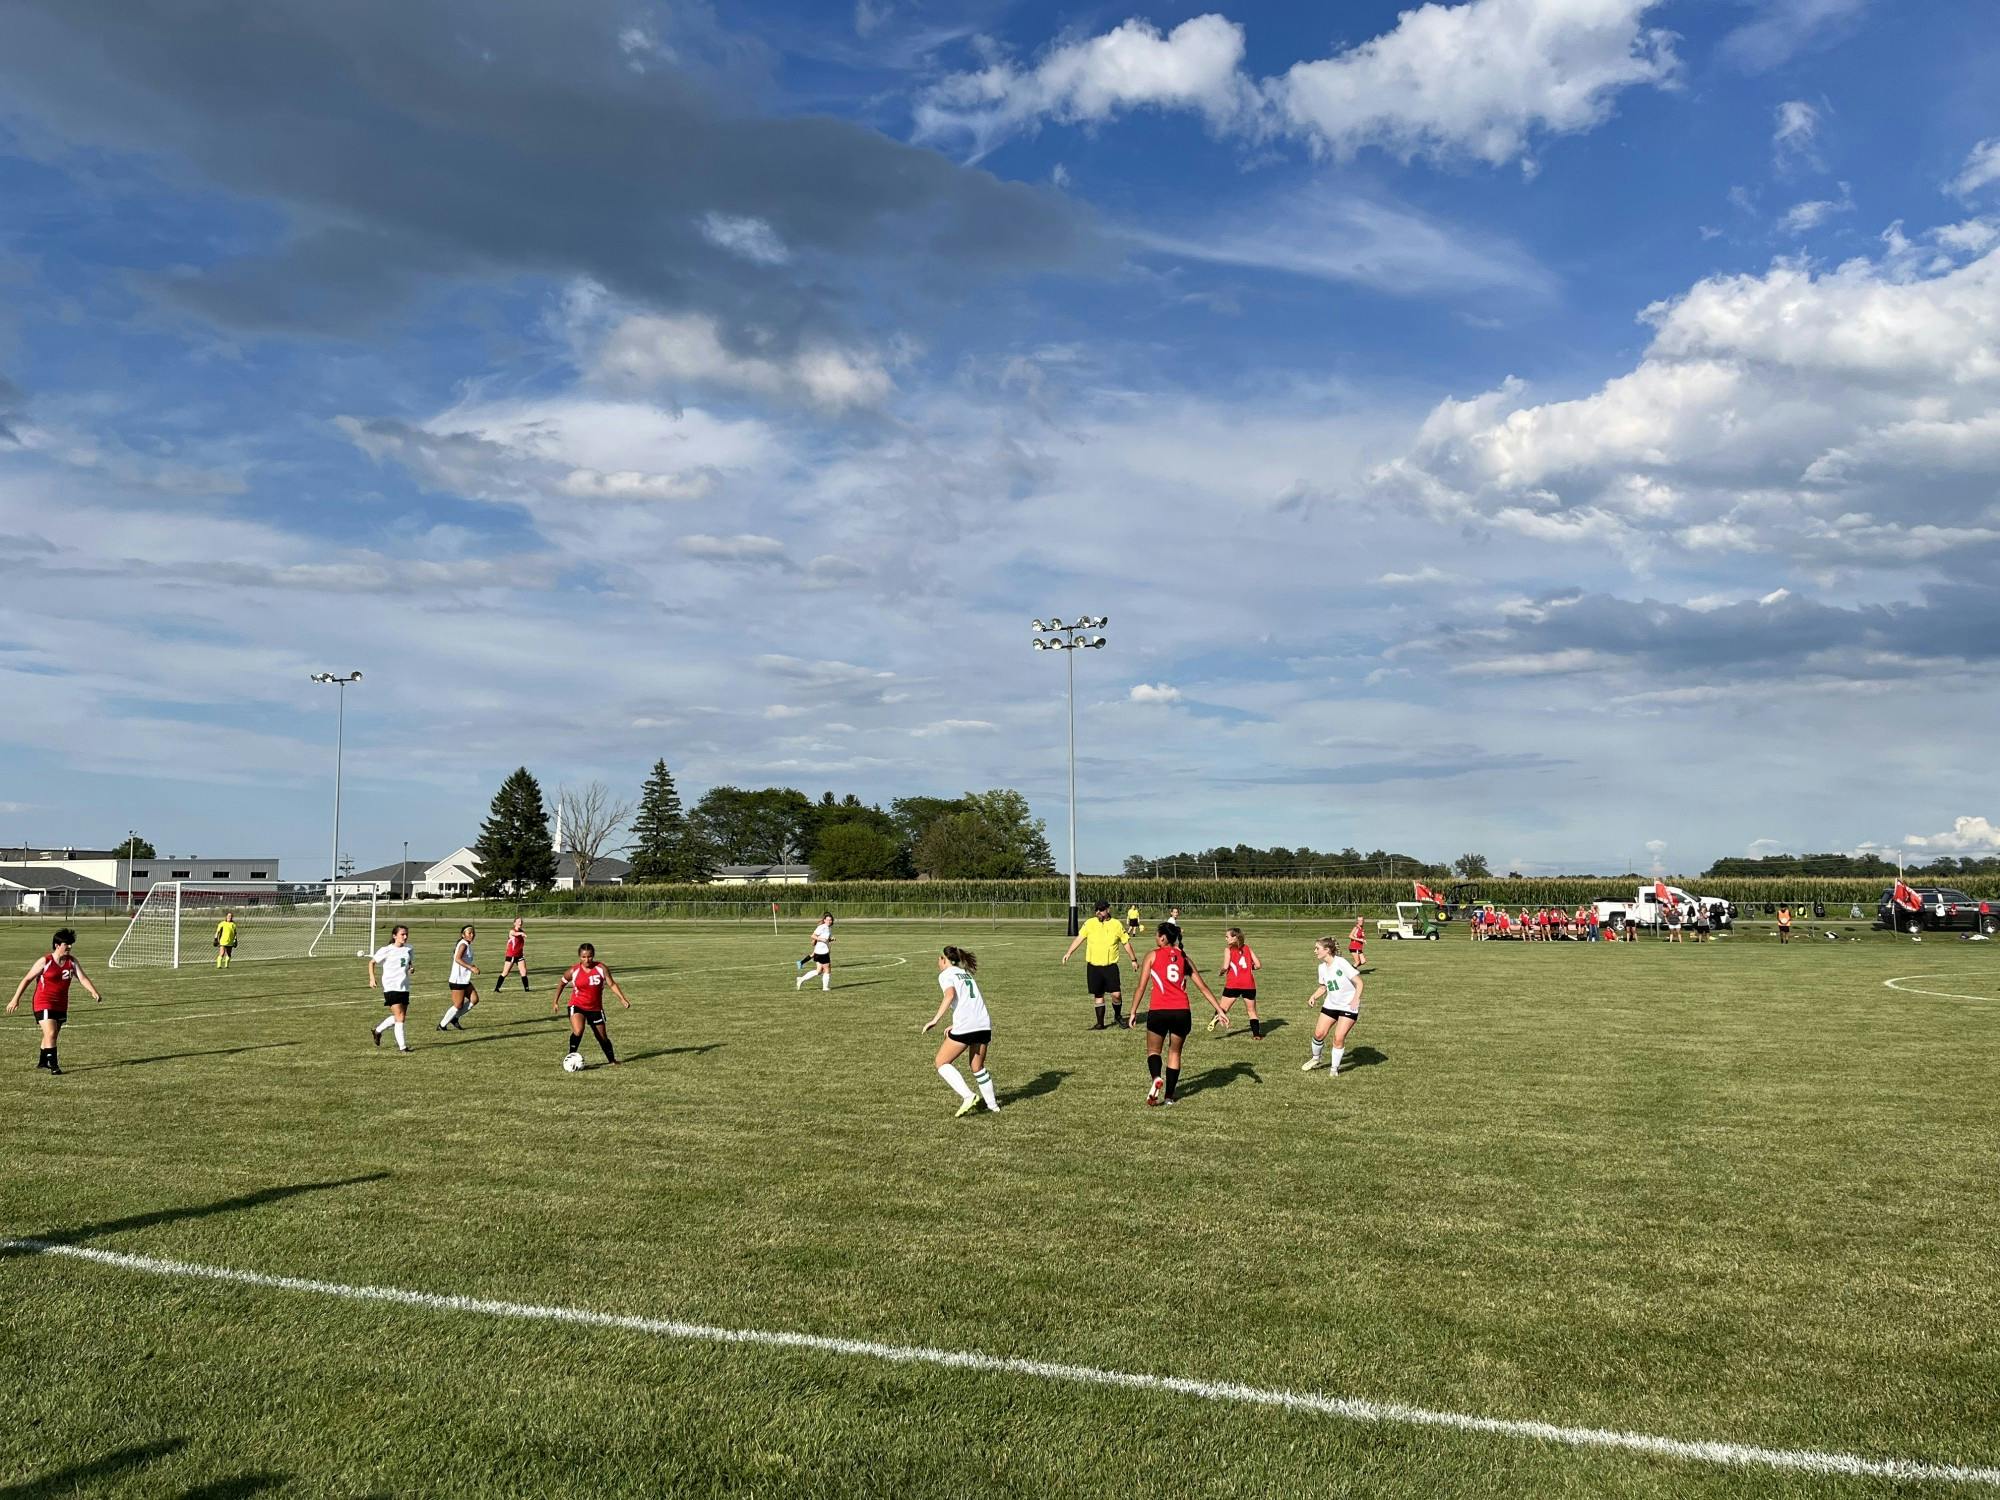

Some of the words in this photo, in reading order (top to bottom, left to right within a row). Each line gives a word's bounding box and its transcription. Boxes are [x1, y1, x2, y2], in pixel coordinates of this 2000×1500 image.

[400, 957, 407, 968] 2
[1238, 956, 1248, 969] 4
[588, 974, 601, 986] 15
[1166, 963, 1179, 984] 6
[964, 979, 976, 998] 7
[1327, 979, 1340, 992] 21
